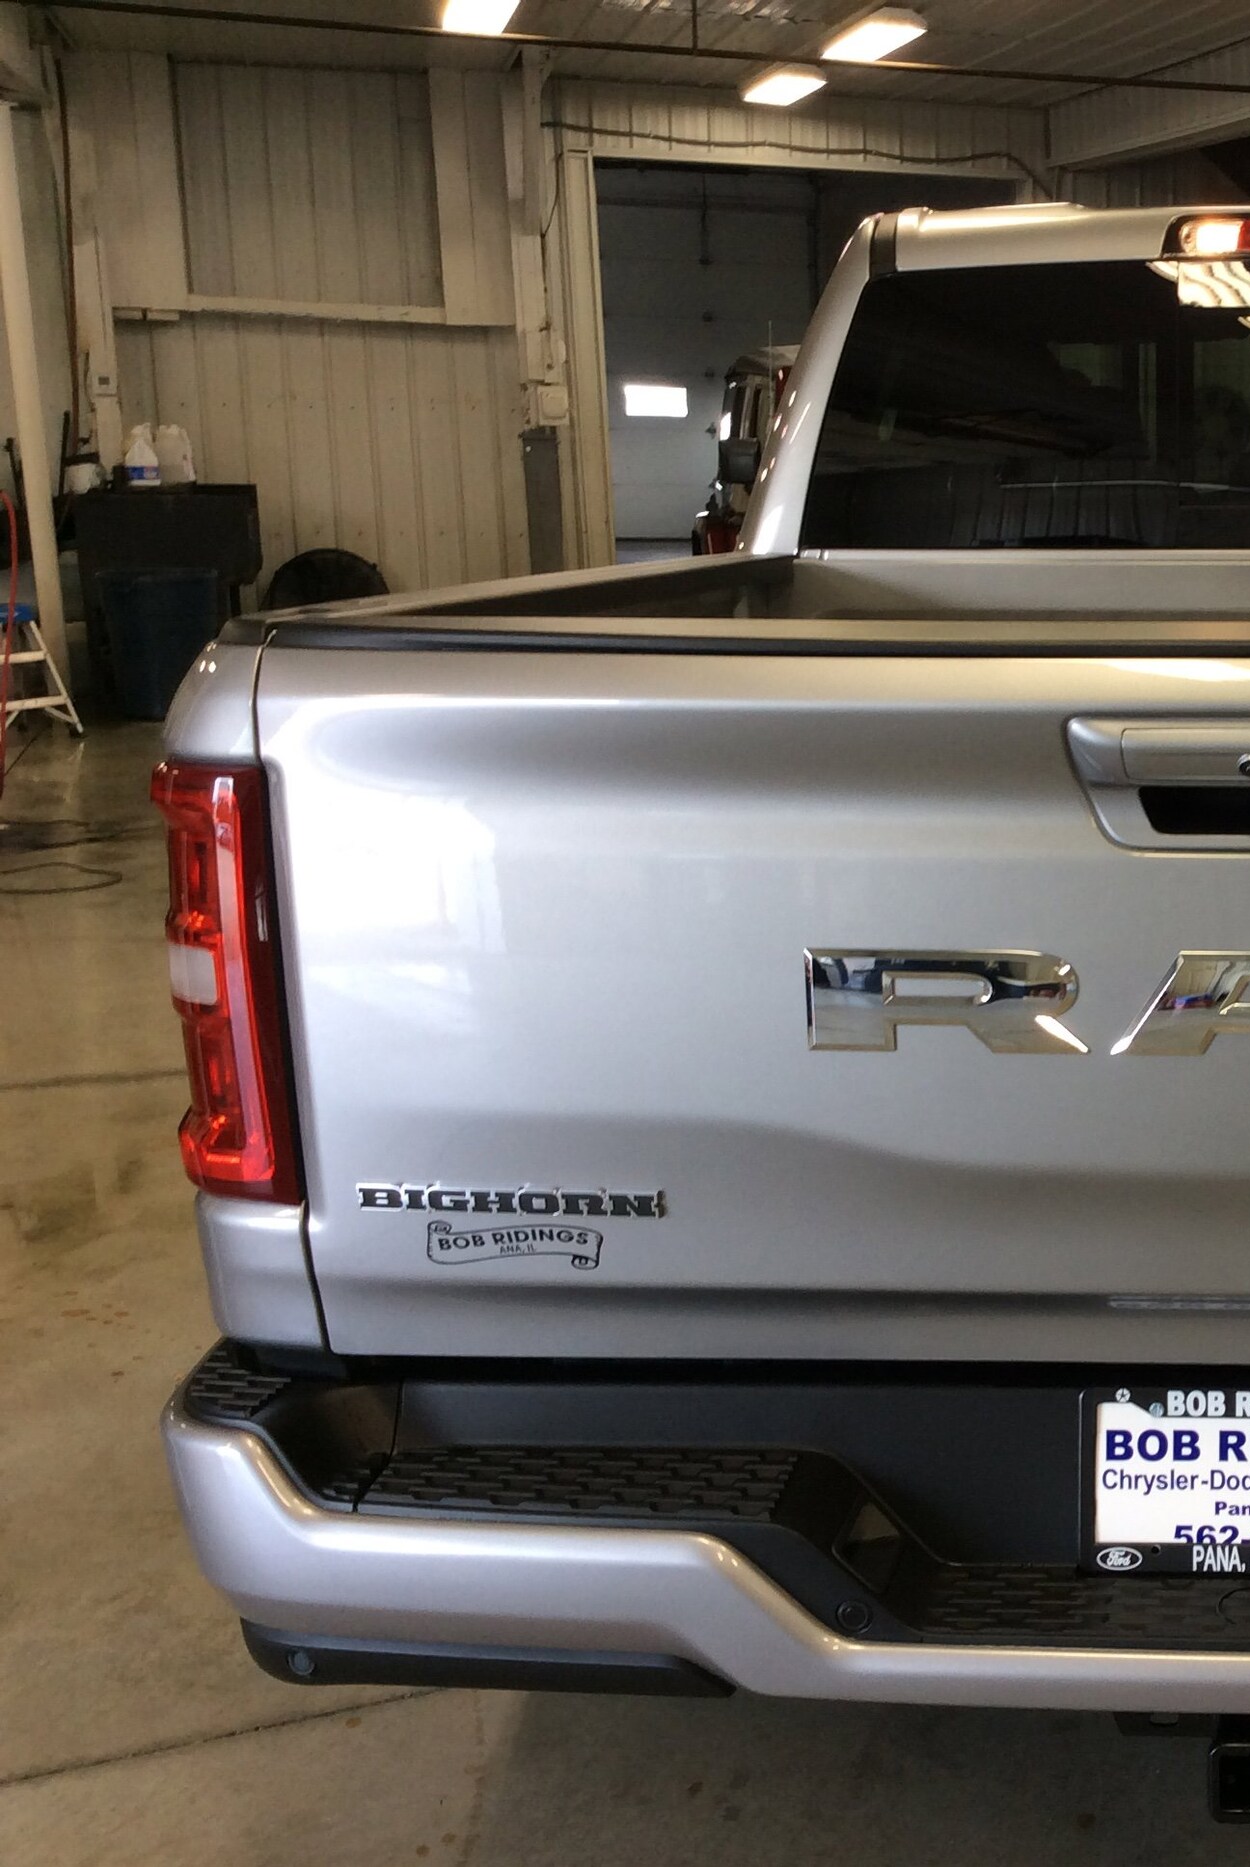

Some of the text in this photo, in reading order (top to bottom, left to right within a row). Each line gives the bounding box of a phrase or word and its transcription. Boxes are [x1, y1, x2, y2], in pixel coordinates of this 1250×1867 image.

[356, 1181, 665, 1219] BIGHORN
[438, 1229, 588, 1251] BOB RIDINGS
[1167, 1390, 1226, 1418] BOB
[1105, 1429, 1201, 1462] BOB
[1192, 1545, 1246, 1573] PANA,
